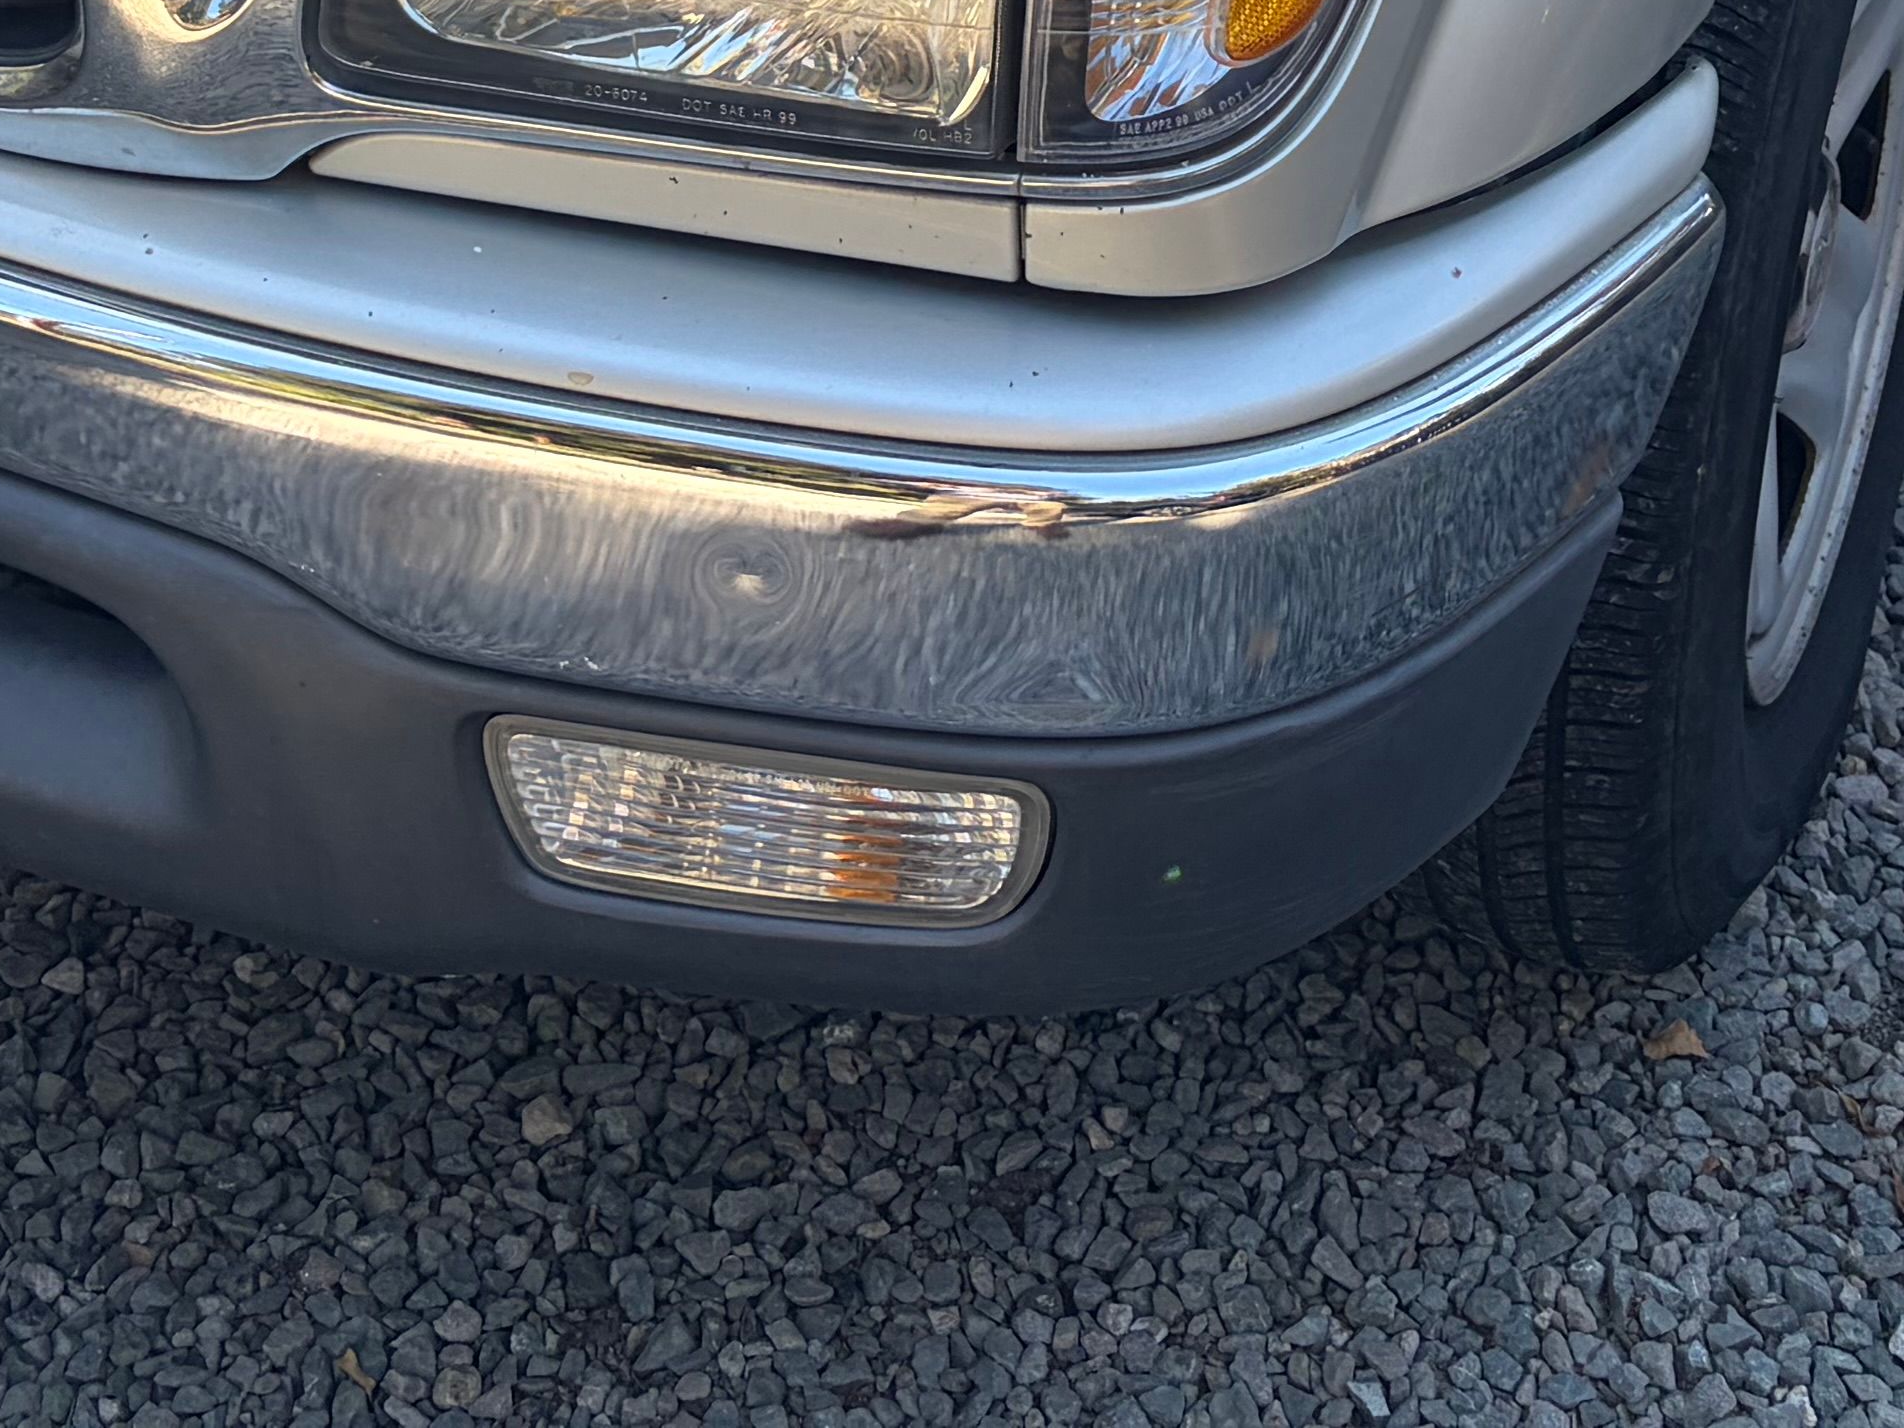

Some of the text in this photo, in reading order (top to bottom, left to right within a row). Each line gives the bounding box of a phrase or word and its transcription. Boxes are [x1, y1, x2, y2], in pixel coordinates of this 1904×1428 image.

[682, 97, 712, 112] DOT
[719, 104, 746, 118] SAE
[778, 111, 797, 125] 99
[1119, 122, 1141, 135] SAE
